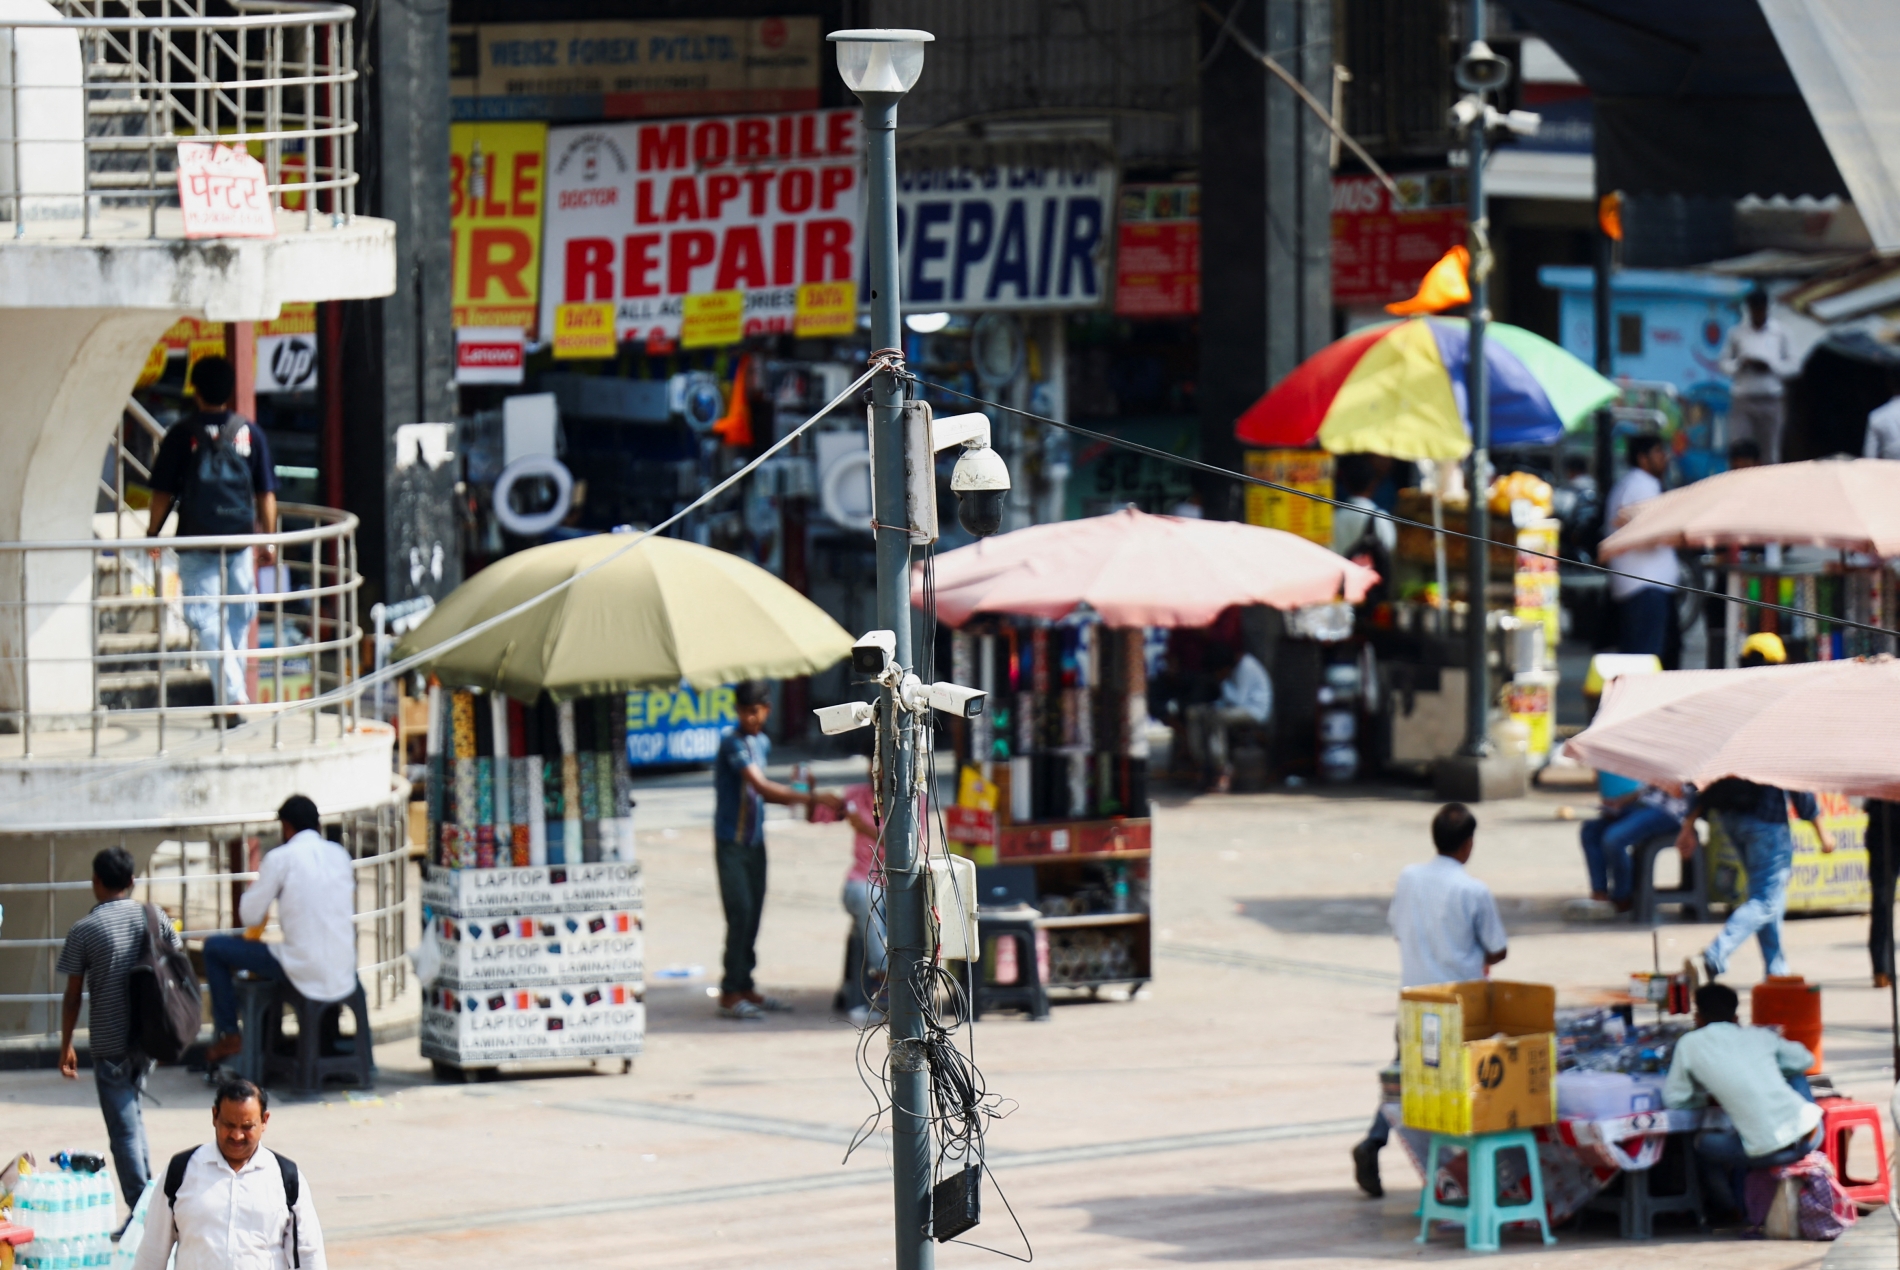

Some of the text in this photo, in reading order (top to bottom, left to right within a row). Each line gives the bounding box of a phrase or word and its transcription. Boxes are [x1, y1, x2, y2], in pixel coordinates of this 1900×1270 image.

[568, 38, 640, 65] FOREX
[638, 111, 857, 172] MOBILE
[558, 186, 619, 210] DOCTOR
[635, 165, 856, 225] LAPTOP
[564, 217, 855, 304] REPAIR
[275, 339, 313, 385] hp
[461, 343, 517, 365] Lenovo
[474, 865, 641, 889] LAPTOP LAPTOP
[466, 890, 552, 906] LAMINATION
[471, 938, 635, 961] LAPTOP LAPTOP
[463, 963, 549, 979] LAMINATION
[471, 1010, 635, 1031] LAPTOP LAPTOP
[462, 1034, 549, 1049] LAMINATION
